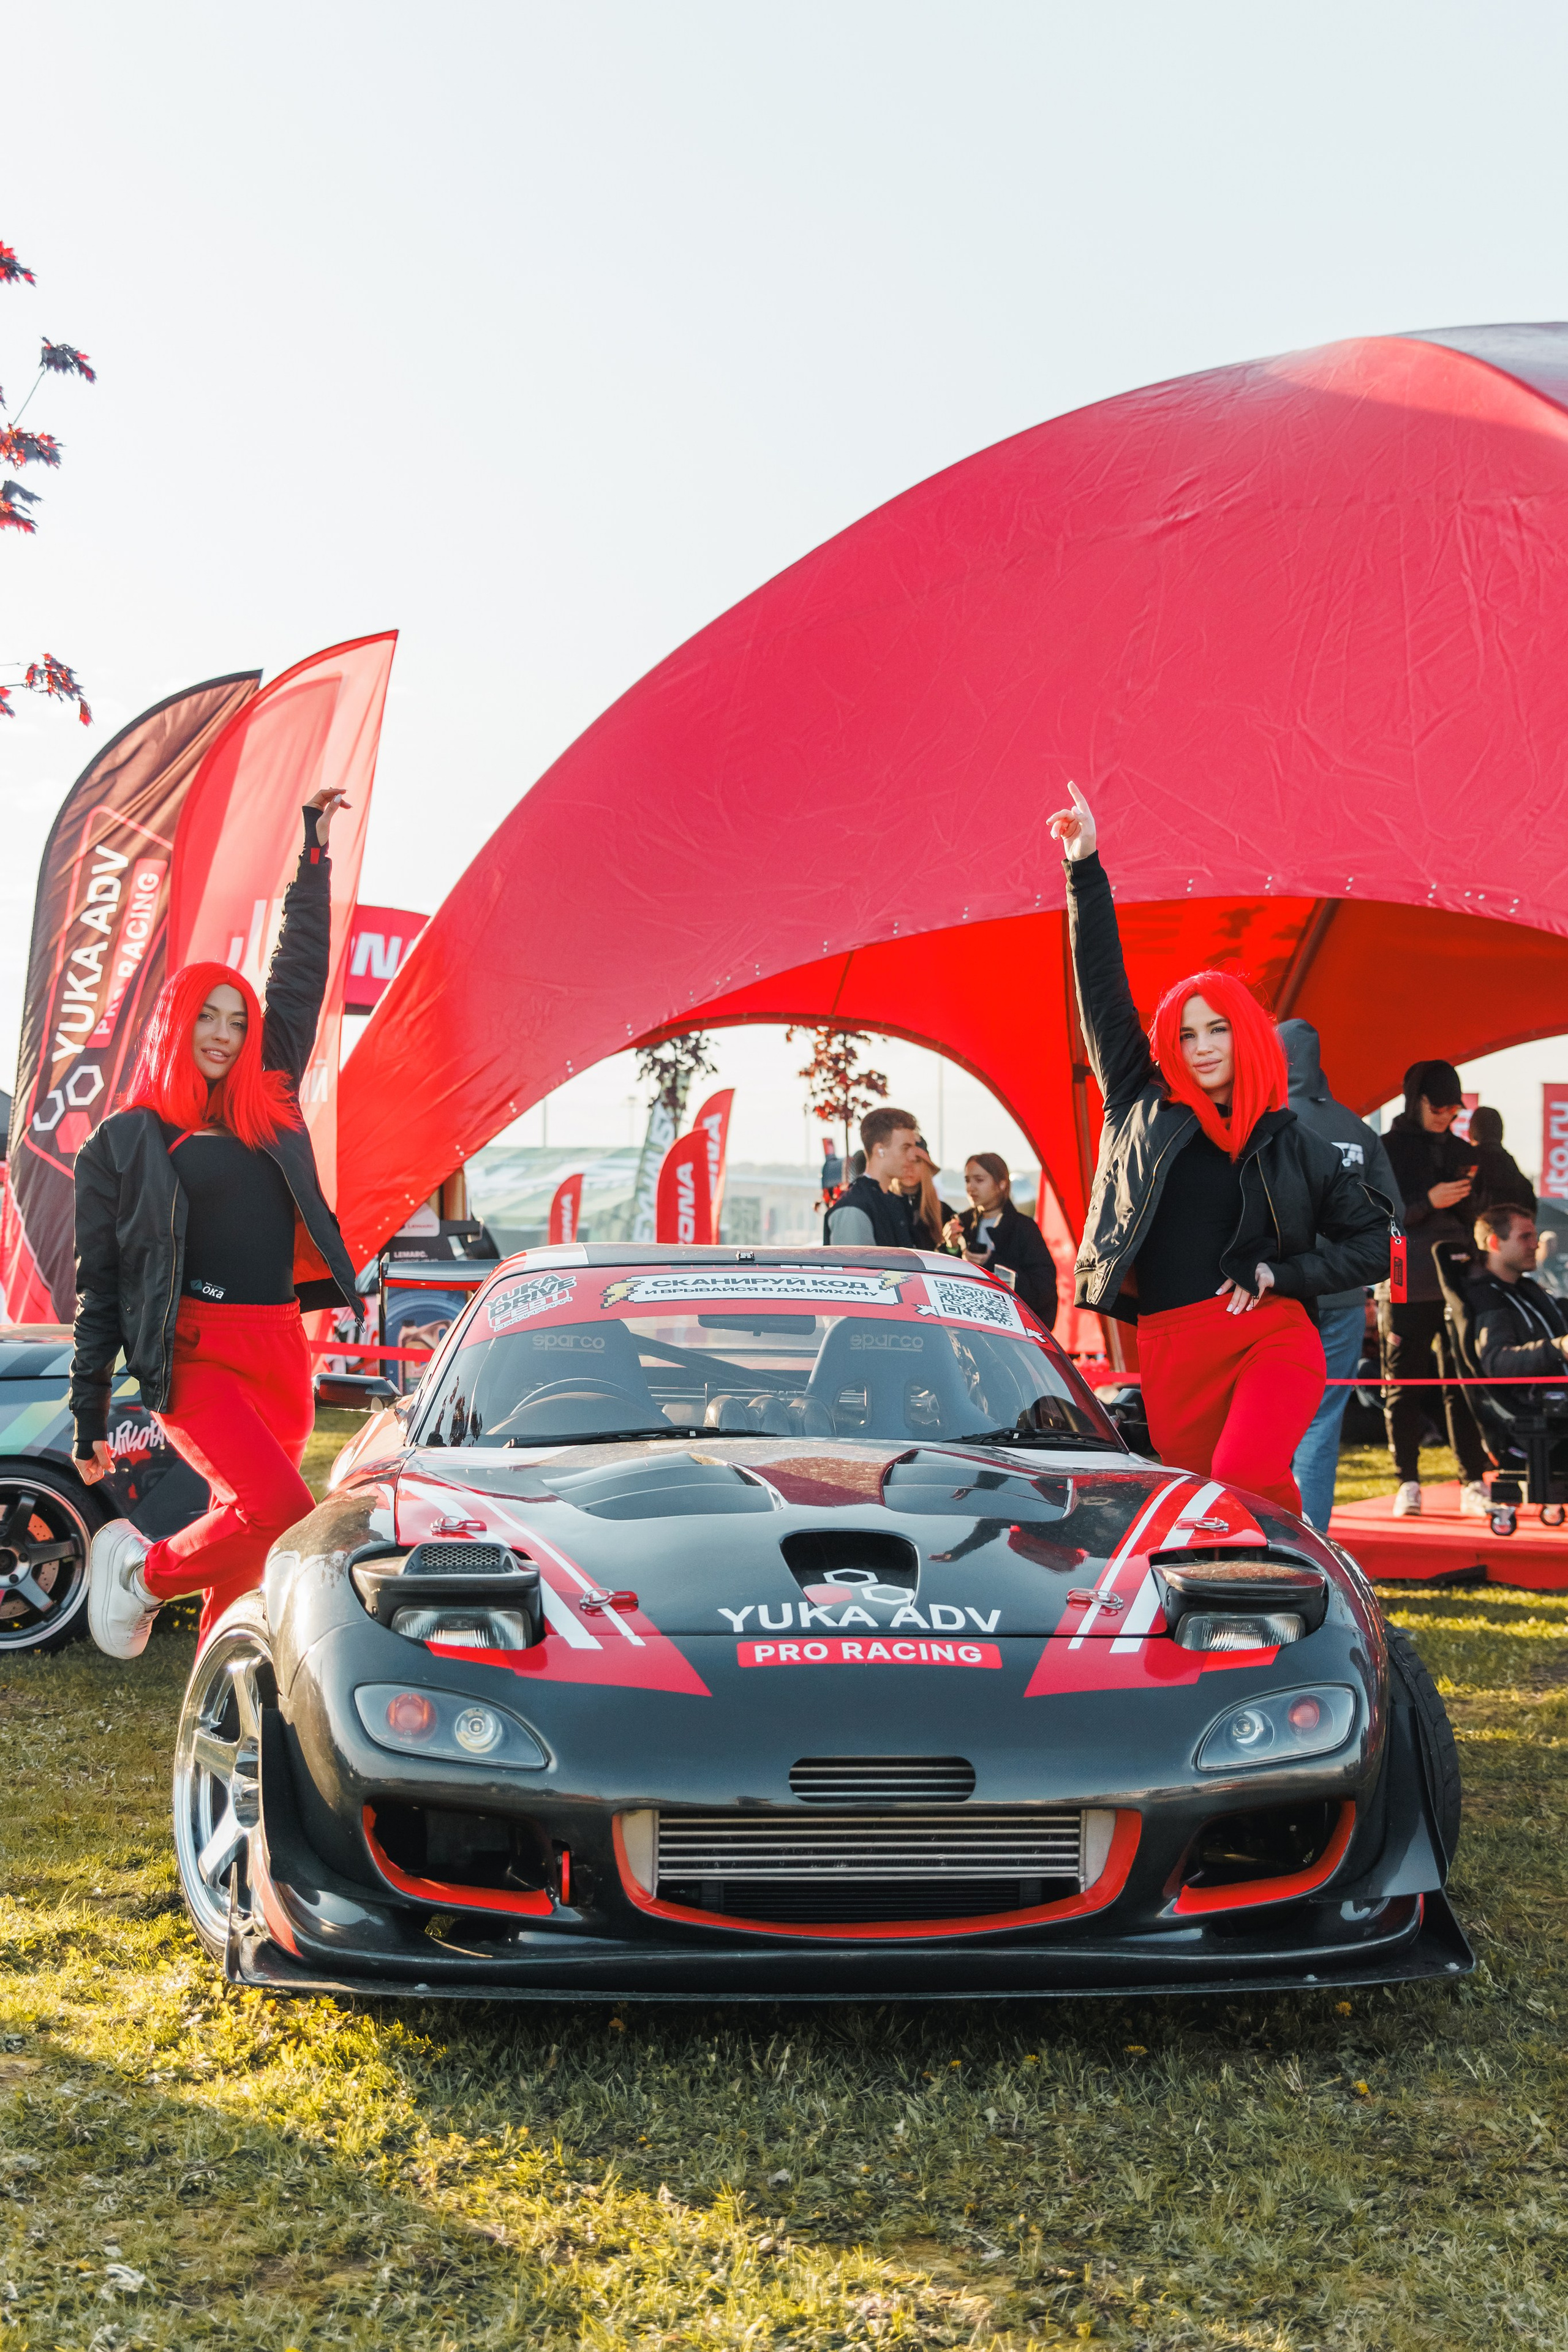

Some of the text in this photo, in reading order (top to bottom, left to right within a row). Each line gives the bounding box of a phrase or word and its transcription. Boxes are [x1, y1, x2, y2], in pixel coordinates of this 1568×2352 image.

[51, 845, 129, 1063] YUKA ADV
[484, 1275, 560, 1308] YUKA
[652, 1277, 869, 1290] СКАНИРУЙ КОД
[777, 1287, 878, 1297] ДЖИМХАНУ
[489, 1276, 576, 1319] DRIVE
[532, 1334, 605, 1351] sparco
[850, 1334, 924, 1351] sparco
[717, 1601, 1001, 1632] YUKA ADV
[754, 1642, 982, 1663] PRO RACING
